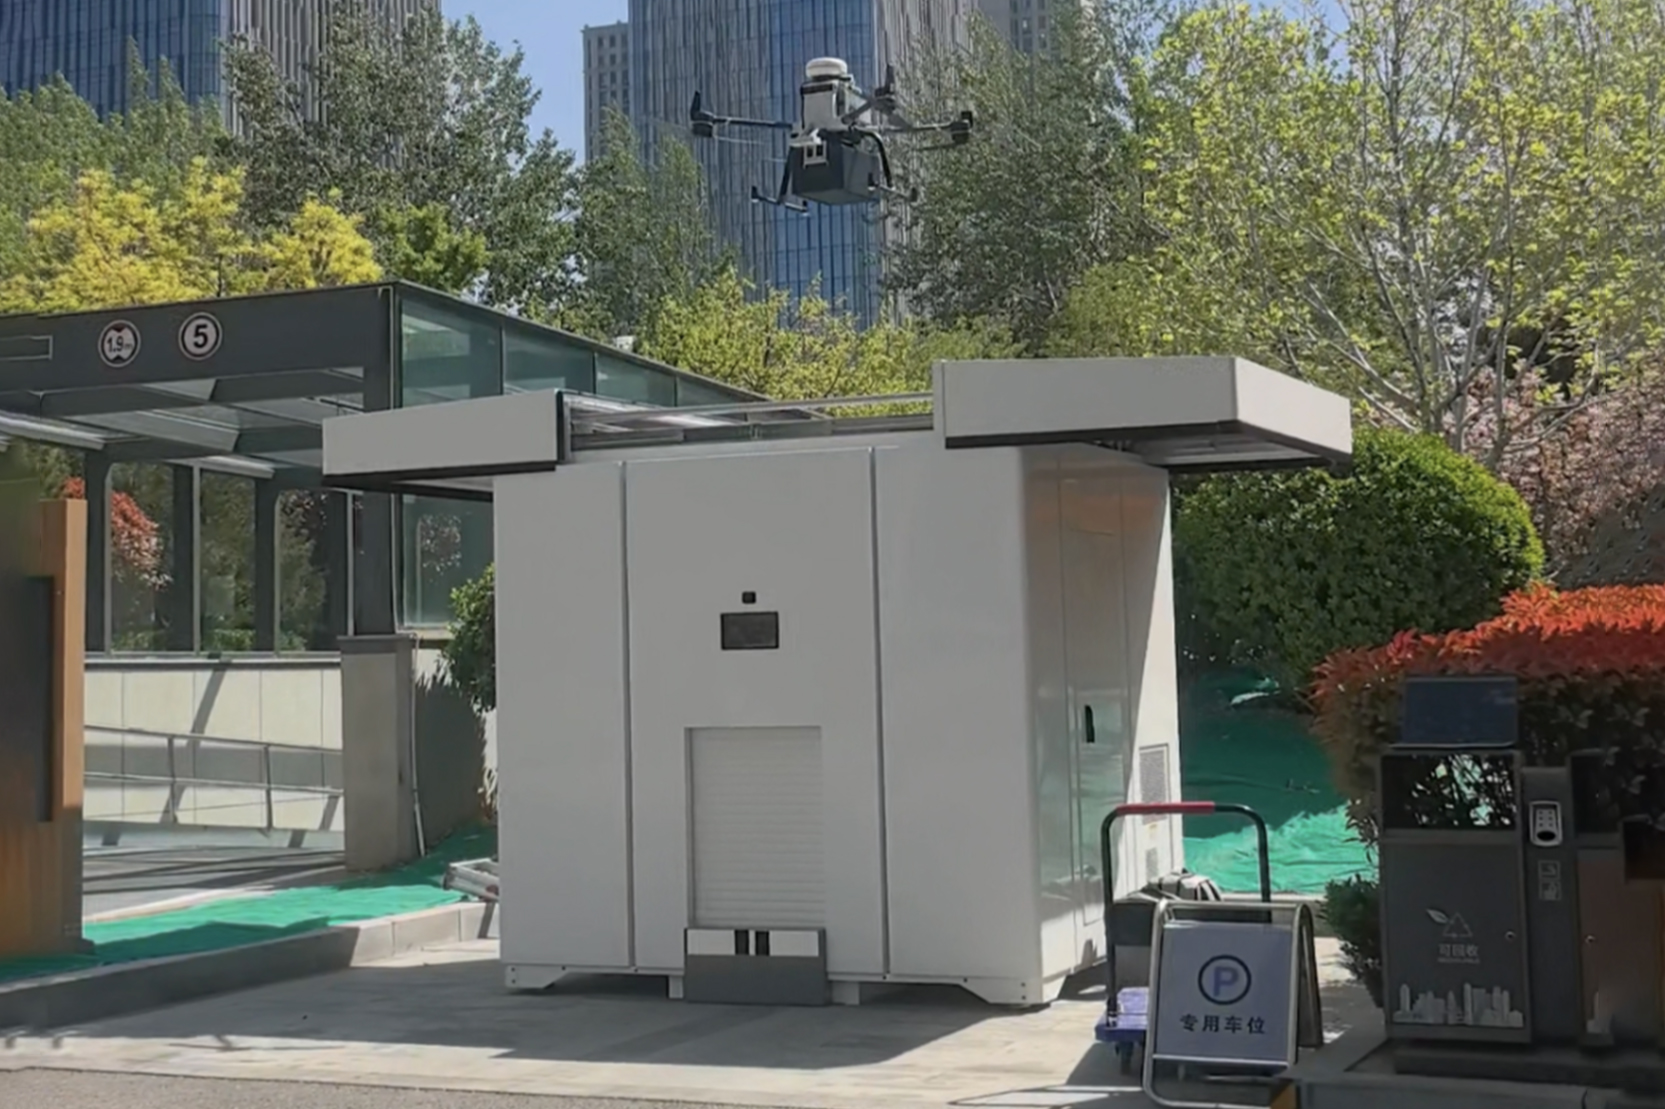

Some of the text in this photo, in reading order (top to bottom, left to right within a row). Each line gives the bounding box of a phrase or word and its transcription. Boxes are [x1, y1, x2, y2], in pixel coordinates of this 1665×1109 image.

[193, 324, 209, 349] 5
[1213, 966, 1239, 997] P
[1180, 1013, 1266, 1034] 专用车位
